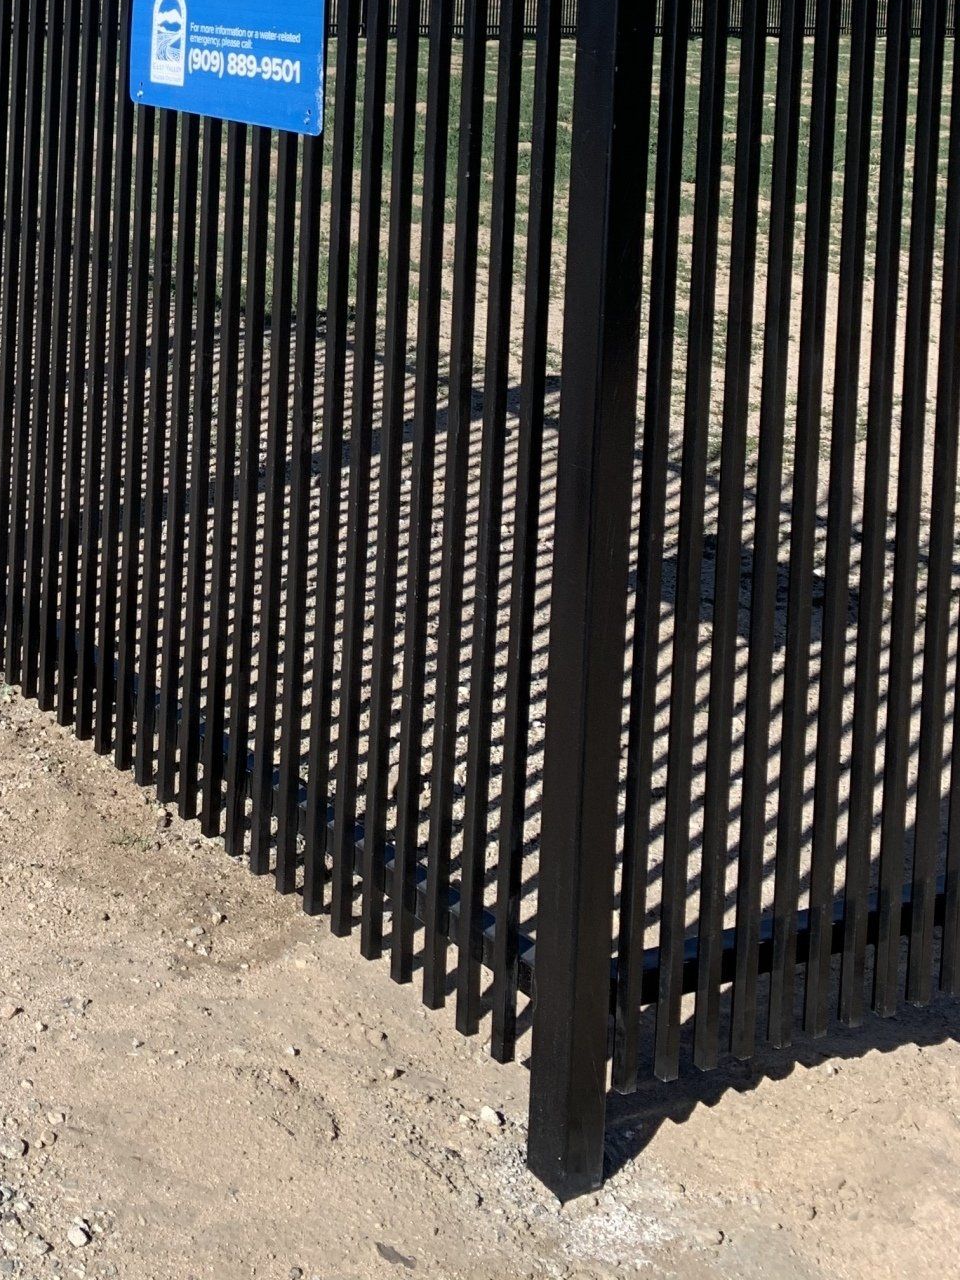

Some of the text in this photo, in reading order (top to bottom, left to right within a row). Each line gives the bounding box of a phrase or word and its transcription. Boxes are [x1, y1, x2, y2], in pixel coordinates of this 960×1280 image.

[190, 22, 200, 32] For
[200, 25, 214, 34] more
[215, 24, 247, 37] information
[247, 29, 254, 38] or
[259, 30, 301, 43] water-related
[221, 37, 240, 48] please
[188, 47, 301, 84] (909) 889-9501
